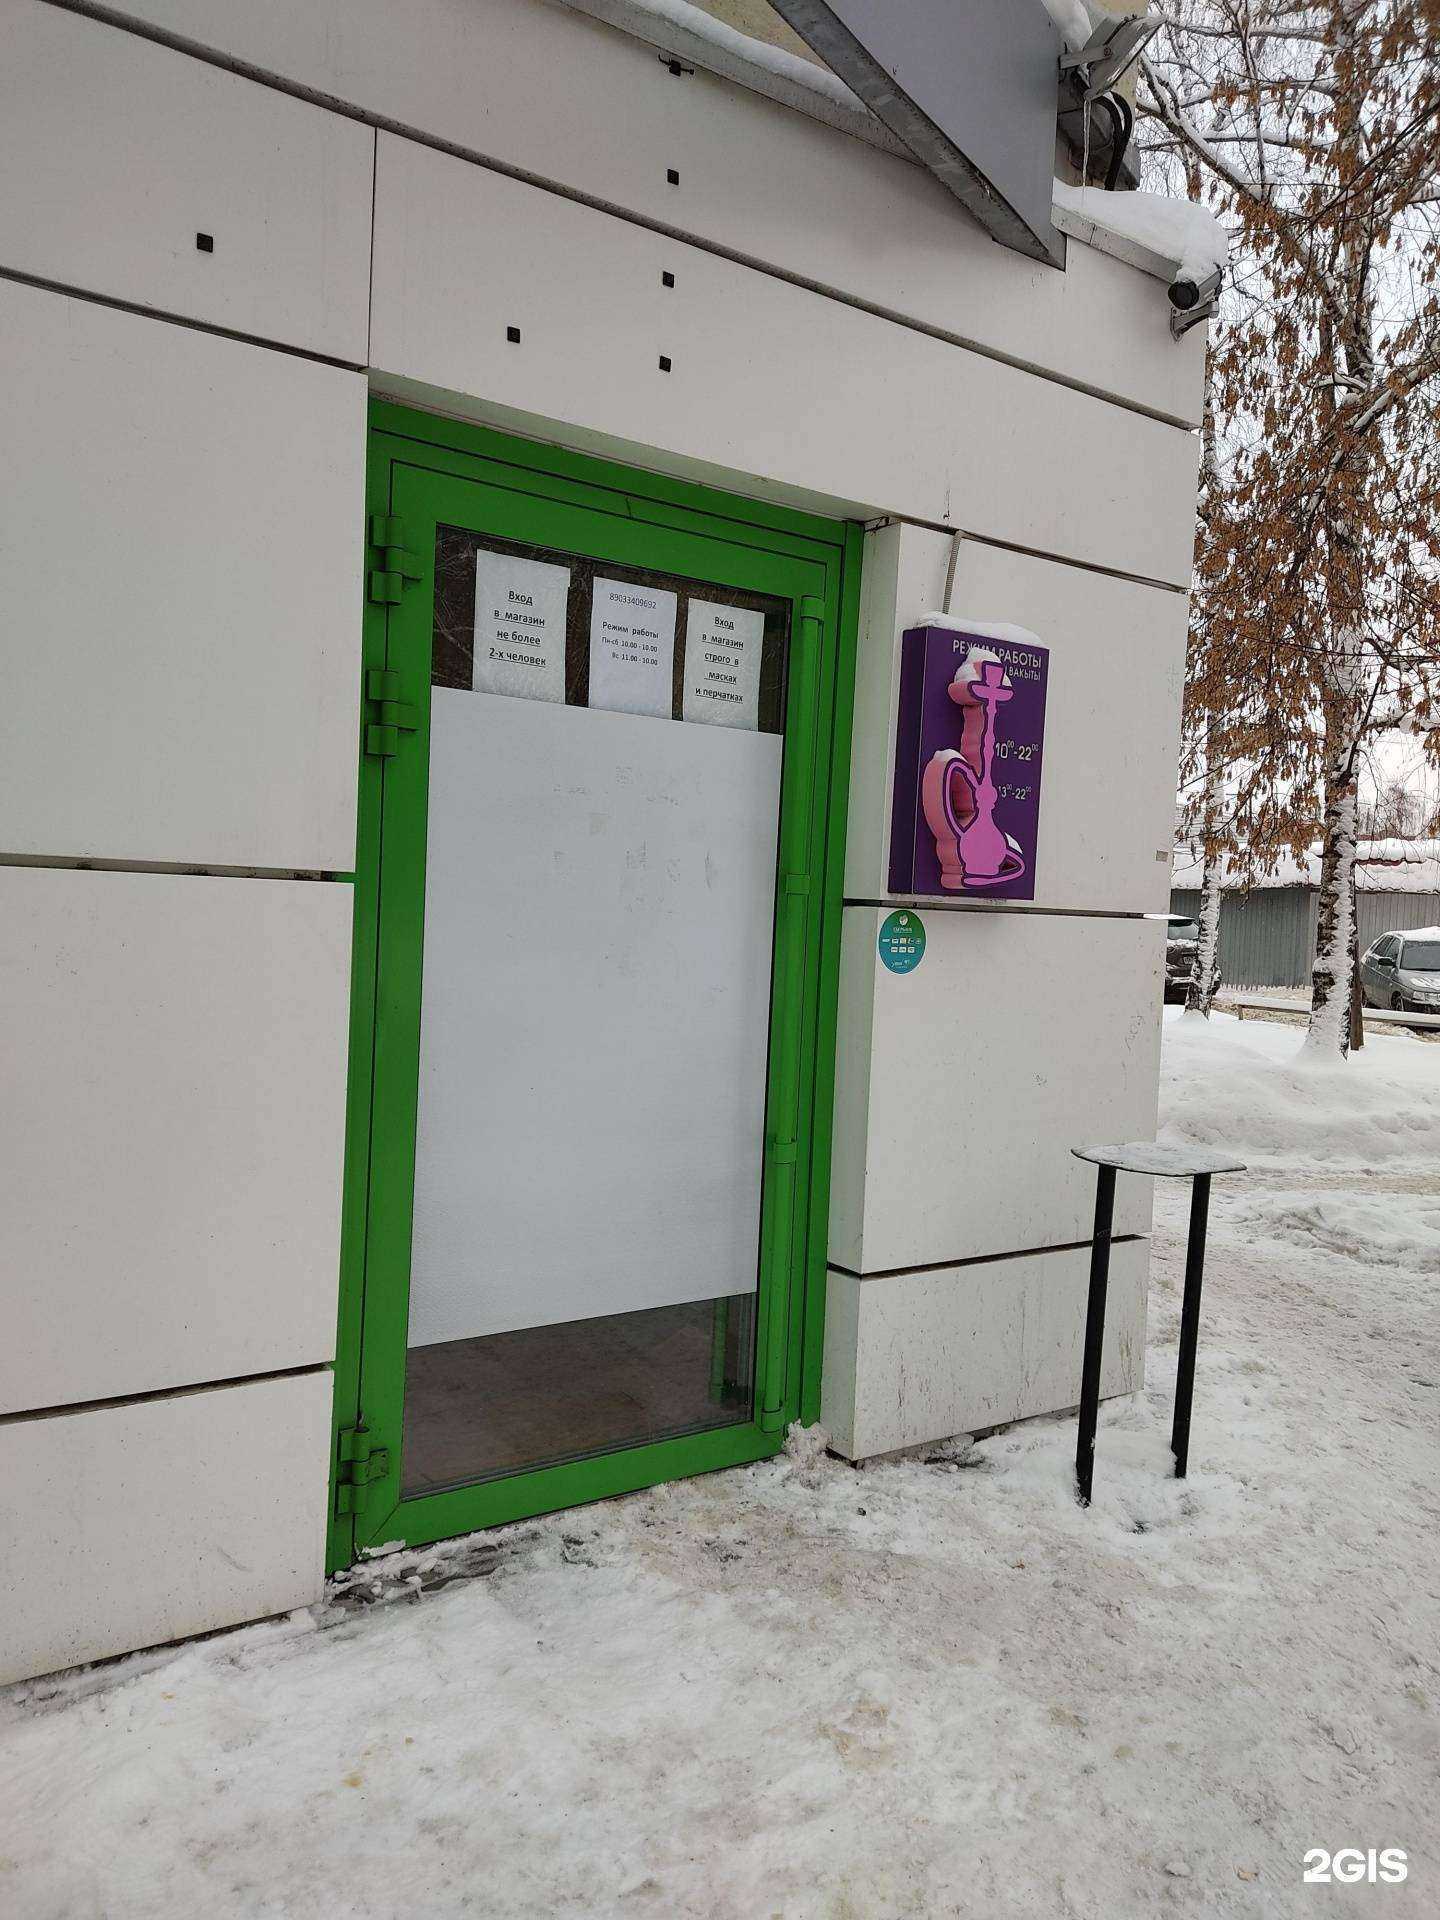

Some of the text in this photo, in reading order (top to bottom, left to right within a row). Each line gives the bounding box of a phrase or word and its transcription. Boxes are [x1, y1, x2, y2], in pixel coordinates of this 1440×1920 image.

[508, 590, 533, 606] Вход
[494, 609, 545, 627] в магазин
[714, 616, 734, 630] Вход
[496, 630, 541, 645] не более
[602, 621, 659, 640] Режим работы
[702, 633, 744, 649] в магазин
[489, 647, 546, 666] 2-х человек
[704, 653, 731, 664] строго
[999, 647, 1042, 669] РАБОТЫ
[708, 671, 737, 684] масках
[696, 687, 743, 702] и перчатках
